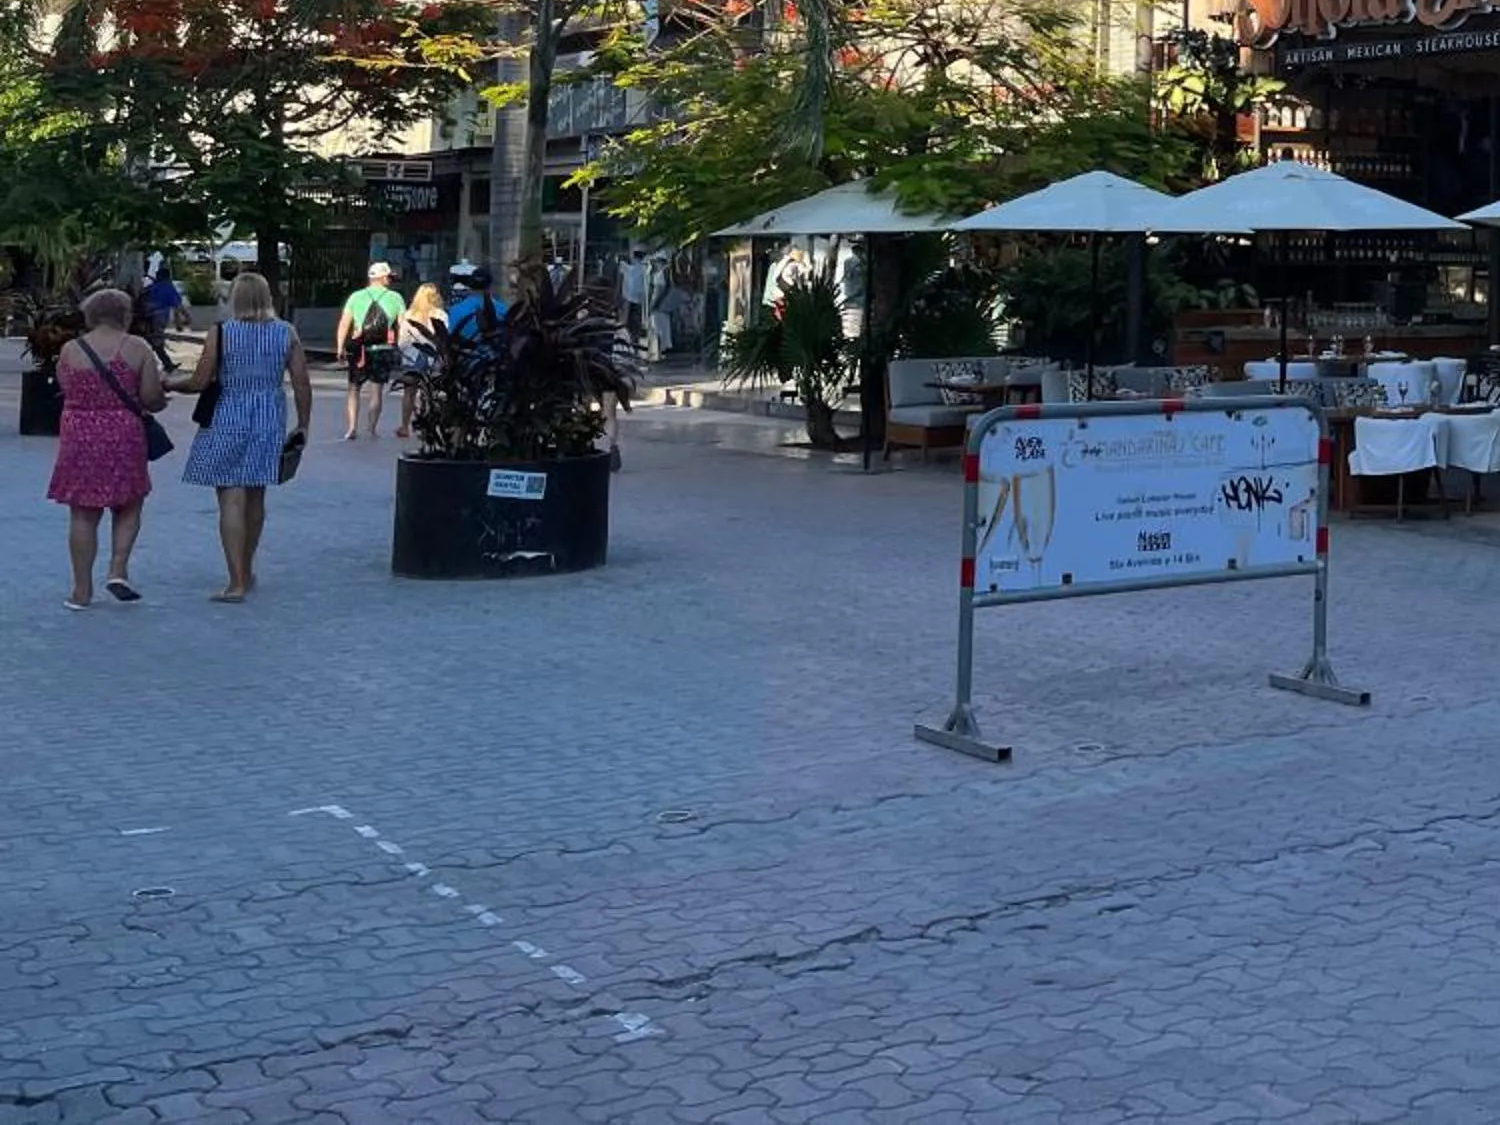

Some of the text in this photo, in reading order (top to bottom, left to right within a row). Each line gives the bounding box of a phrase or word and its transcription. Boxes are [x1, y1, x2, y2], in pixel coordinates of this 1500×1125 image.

[1284, 32, 1500, 66] ARTISAN MEXICAN STEAKHOUSE
